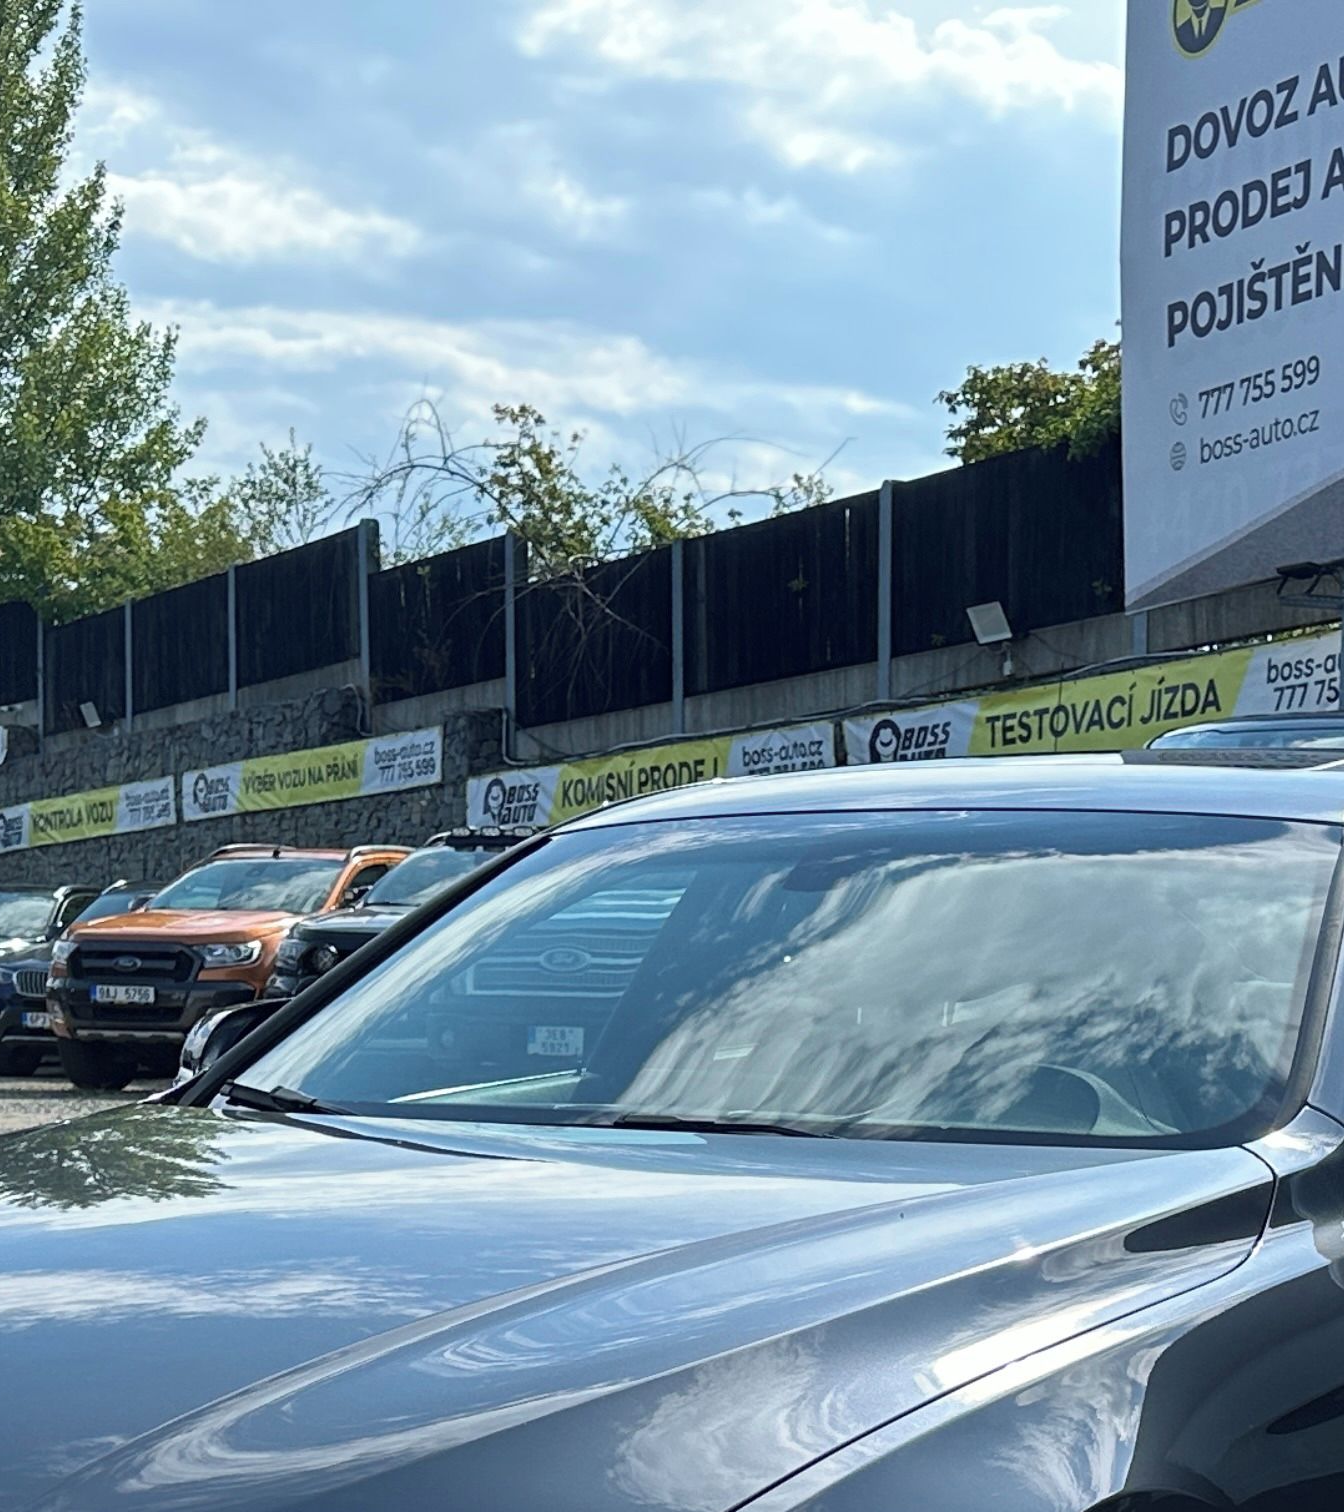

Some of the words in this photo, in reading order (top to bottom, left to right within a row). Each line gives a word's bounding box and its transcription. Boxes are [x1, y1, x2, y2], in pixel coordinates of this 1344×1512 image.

[1167, 74, 1300, 173] DOVOZ
[1163, 157, 1313, 258] PRODEJ
[1198, 381, 1235, 419] 777
[1239, 368, 1276, 406] 755
[1280, 355, 1321, 394] 599
[1200, 409, 1320, 465] boss-auto.cz
[985, 684, 1135, 750] TESTOVACÍ
[1145, 675, 1222, 728] JÍZDA
[1273, 682, 1309, 712] 777
[901, 721, 951, 748] BOSS
[742, 740, 824, 767] boss-auto.cz
[278, 766, 307, 790] VOZU
[308, 764, 325, 784] NA
[506, 782, 541, 804] BOSS
[561, 763, 636, 809] KOMISNÍ
[31, 806, 84, 833] KONTROLA
[85, 799, 114, 825] VOZU
[501, 804, 537, 825] AUTO
